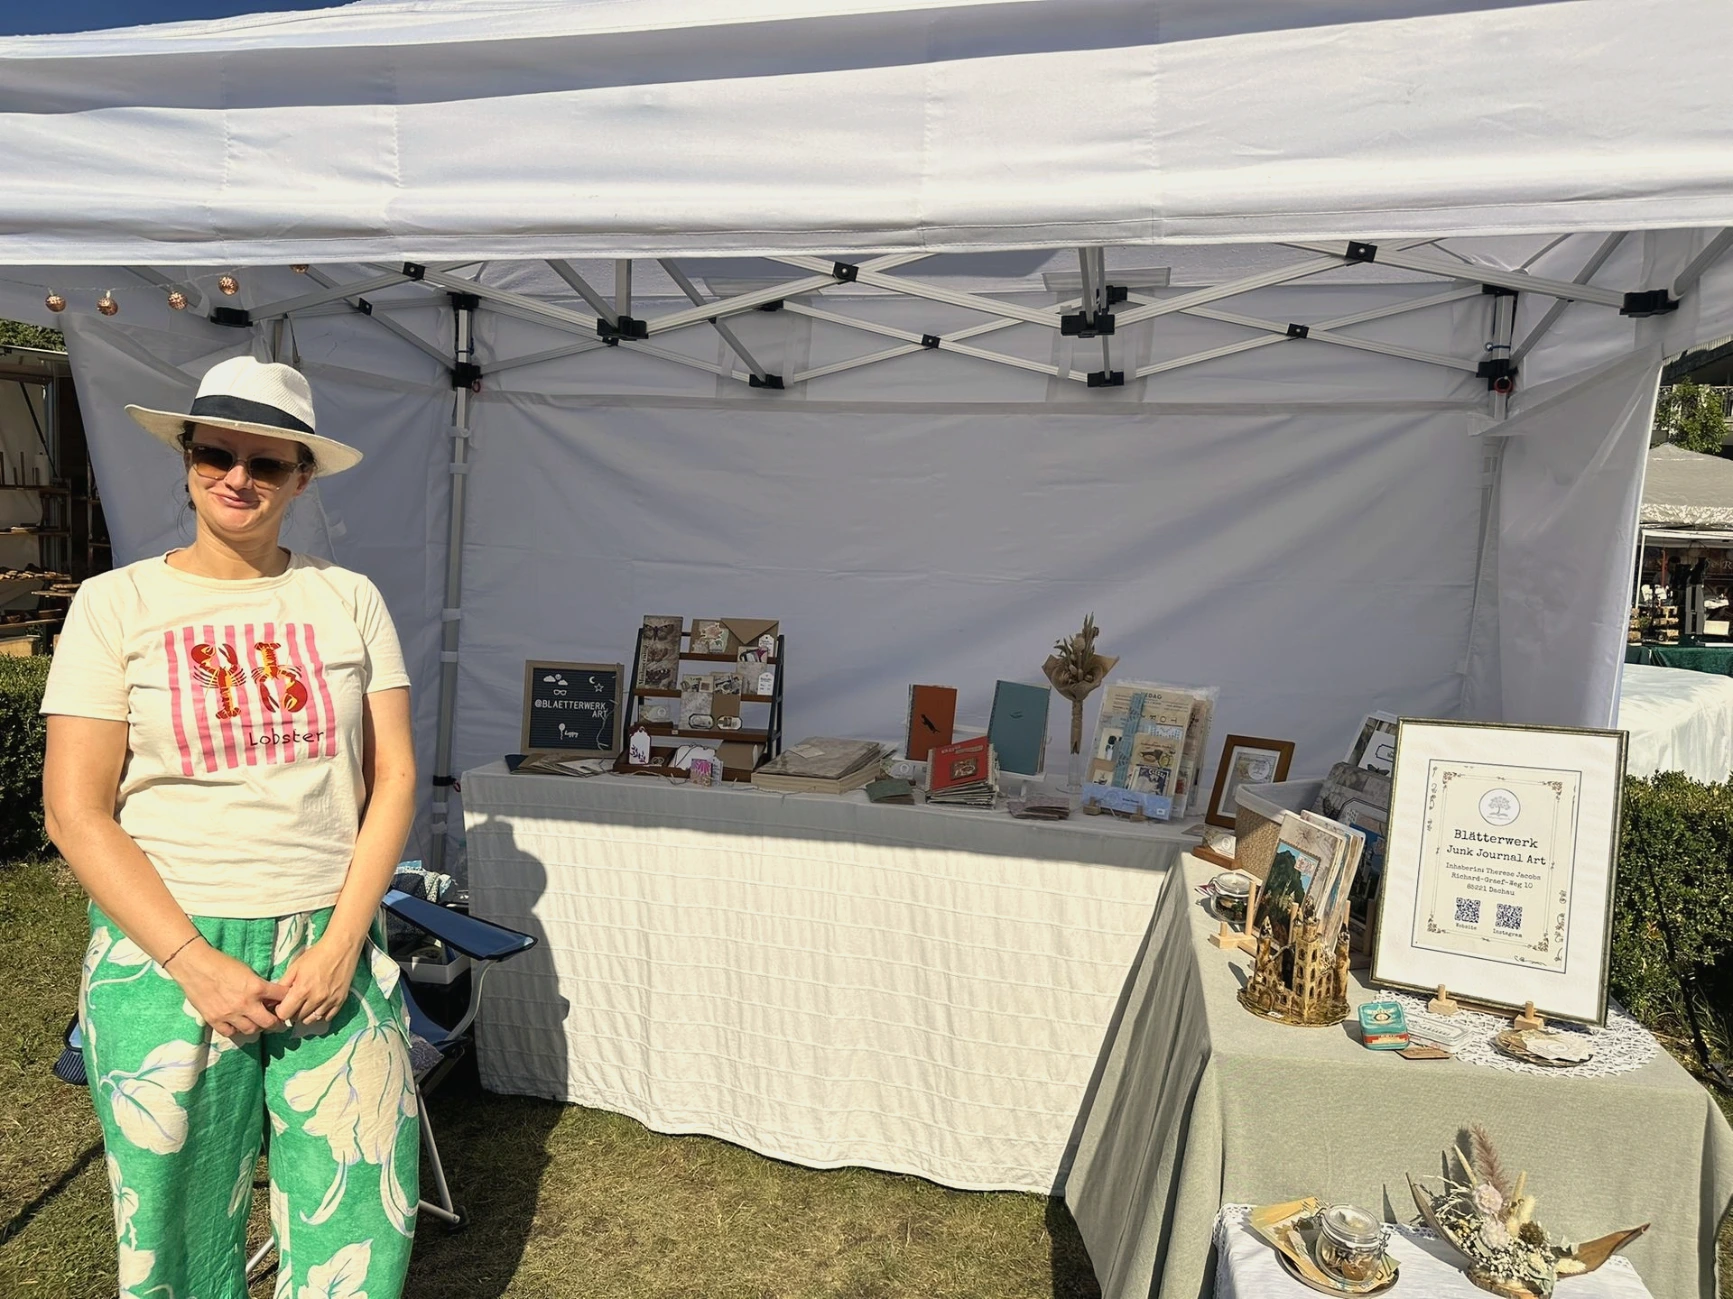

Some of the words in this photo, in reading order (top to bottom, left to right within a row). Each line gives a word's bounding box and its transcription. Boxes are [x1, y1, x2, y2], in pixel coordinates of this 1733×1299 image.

[534, 699, 606, 710] @BLAETTERWERK
[592, 710, 607, 718] ART
[249, 728, 325, 746] Lobster
[1454, 829, 1538, 848] Blätterwerk
[1446, 845, 1474, 856] Junk
[1476, 848, 1524, 862] Journal
[1526, 855, 1547, 865] Art
[1486, 867, 1515, 878] Therese
[1516, 872, 1542, 880] Jacobs
[1489, 886, 1515, 896] Dachau
[1492, 928, 1522, 938] Instagram
